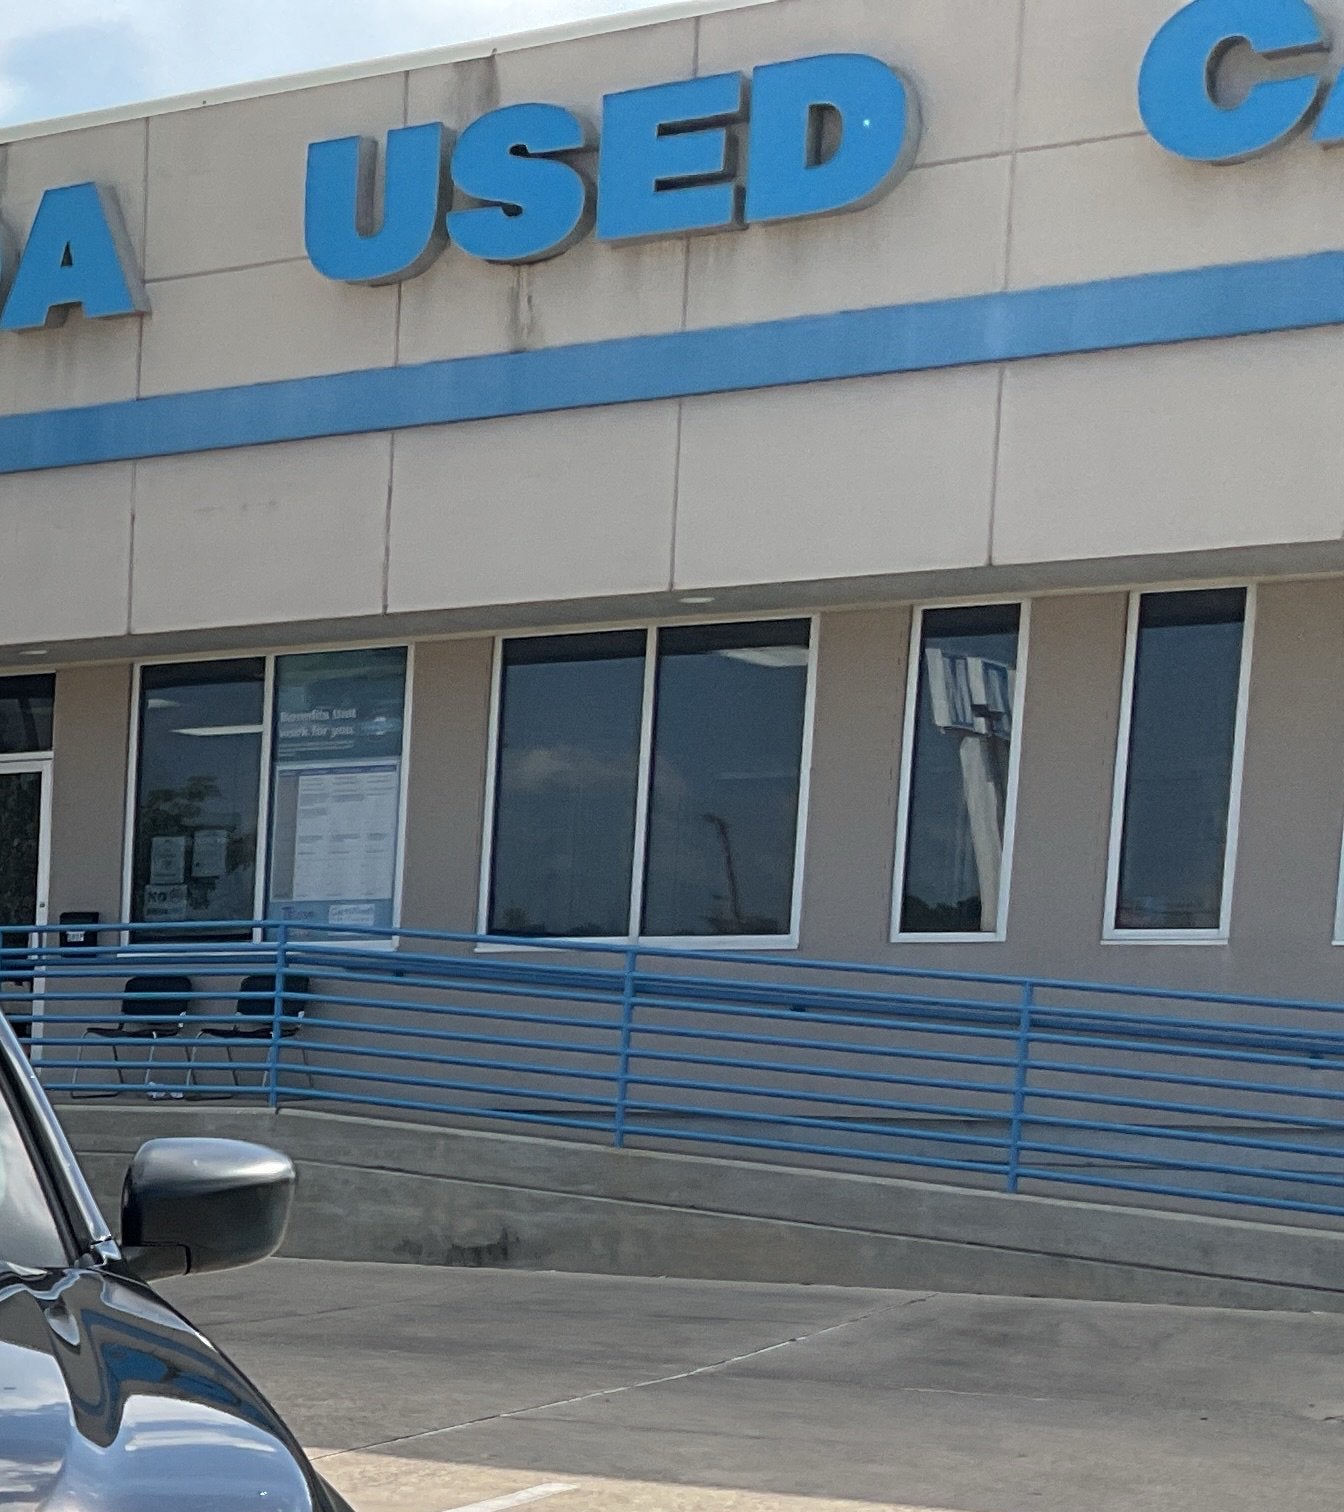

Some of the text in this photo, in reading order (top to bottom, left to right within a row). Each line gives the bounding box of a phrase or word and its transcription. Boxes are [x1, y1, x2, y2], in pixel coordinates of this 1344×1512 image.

[304, 53, 909, 283] USED
[1137, 0, 1344, 163] C
[312, 725, 328, 736] for
